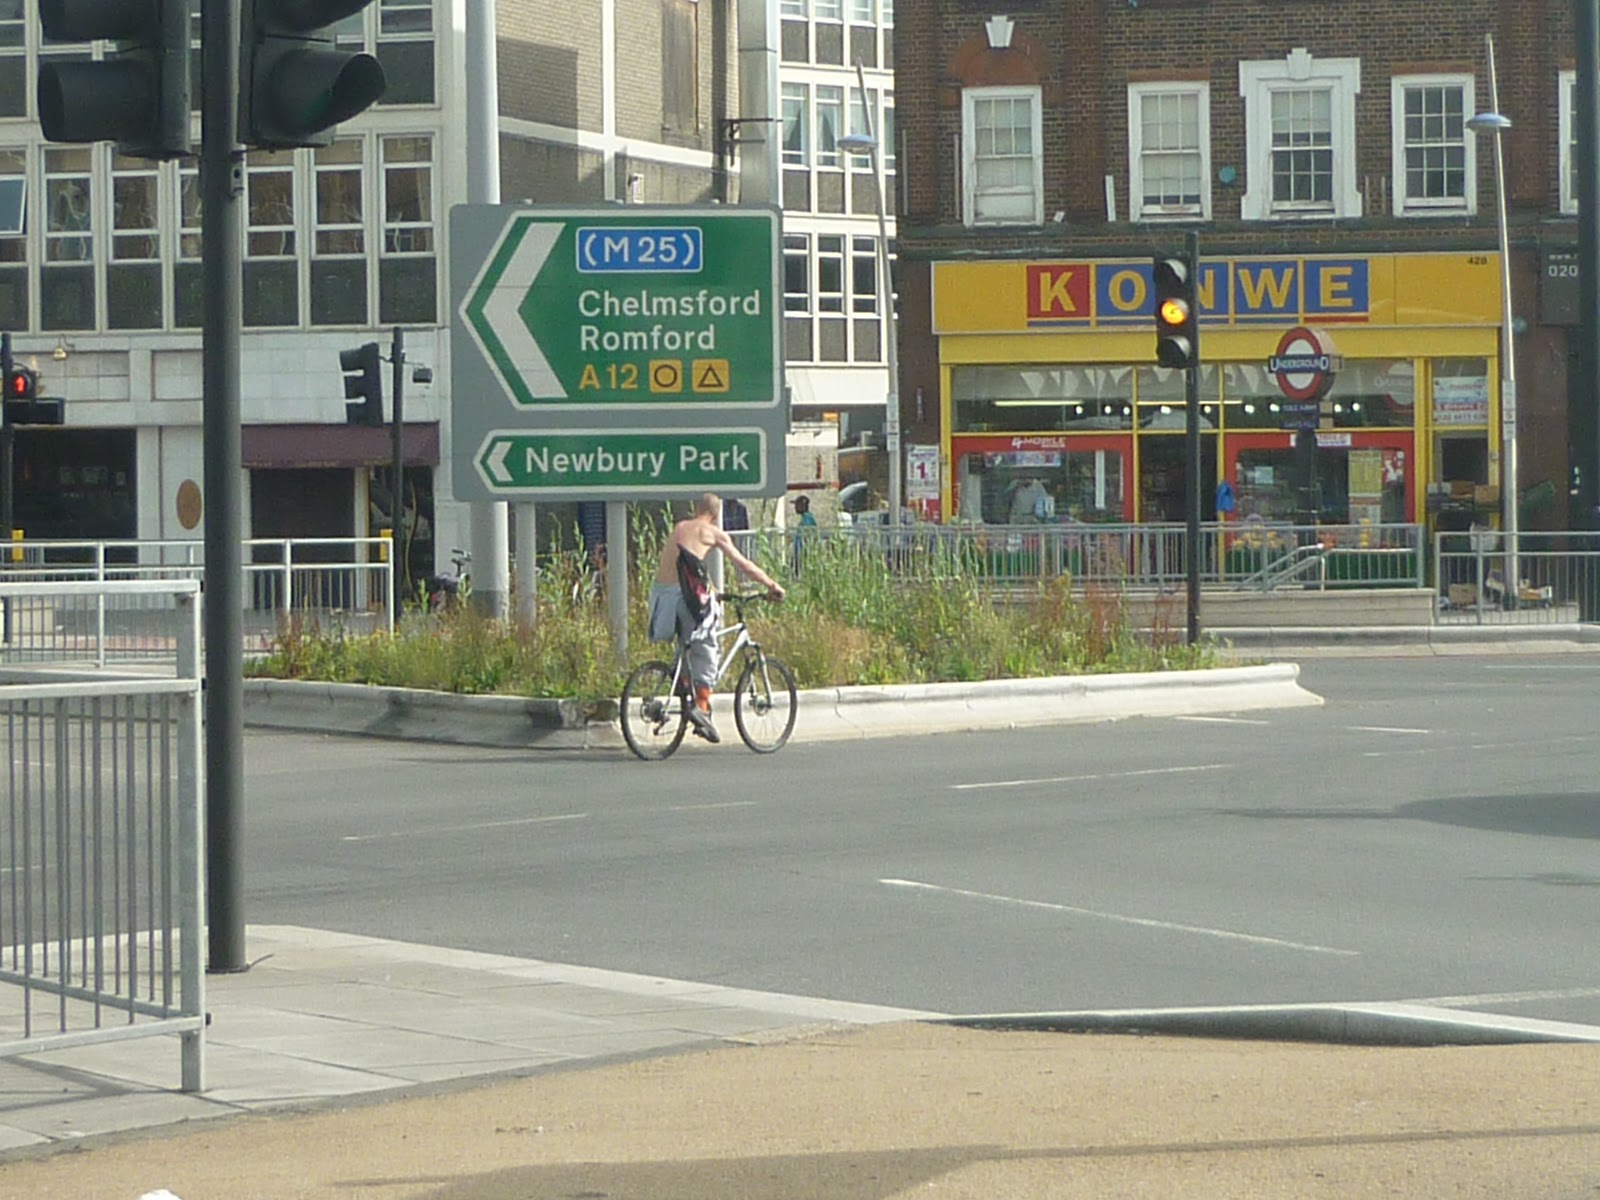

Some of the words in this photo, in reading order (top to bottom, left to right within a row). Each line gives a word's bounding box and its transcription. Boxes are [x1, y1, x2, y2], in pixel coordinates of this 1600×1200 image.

[1548, 265, 1578, 277] 020
[578, 289, 761, 317] Chelmsford
[579, 324, 715, 351] Romford
[525, 447, 665, 477] Newbury
[679, 446, 750, 471] Park
